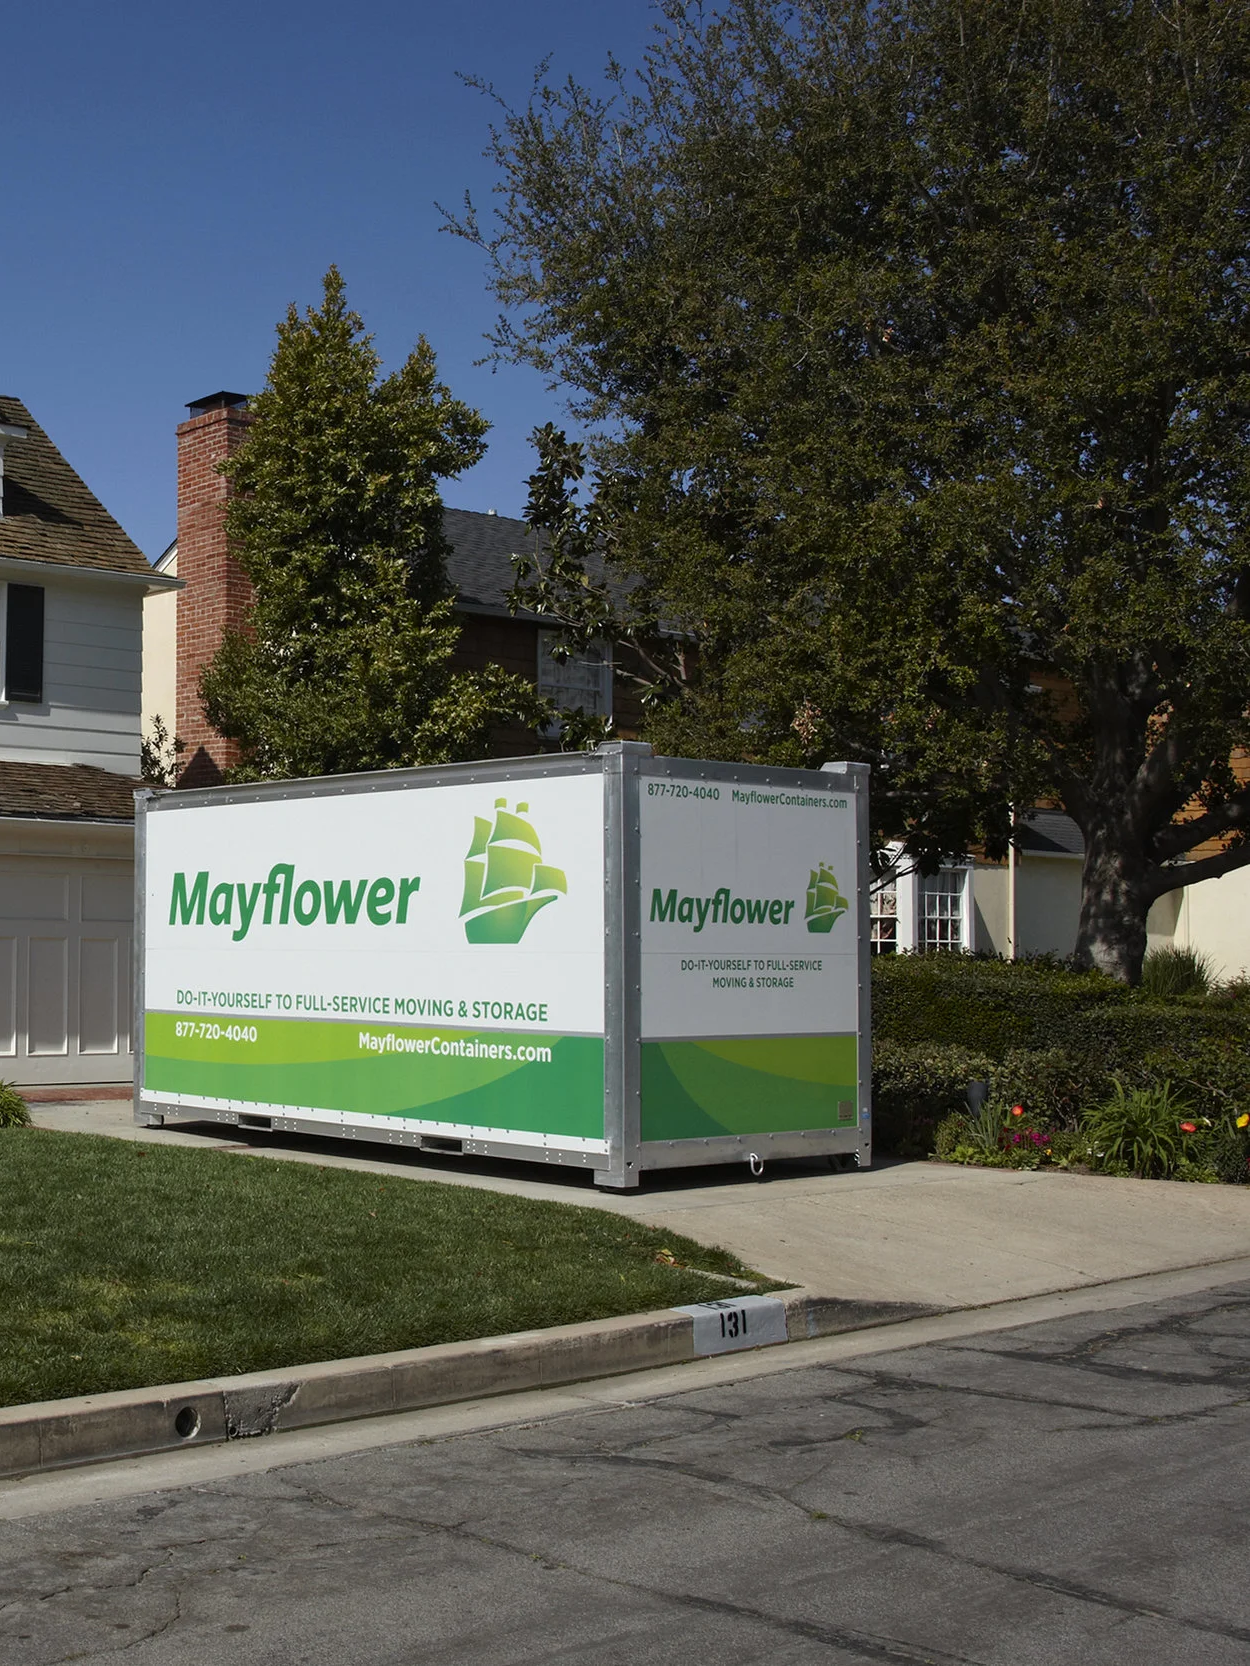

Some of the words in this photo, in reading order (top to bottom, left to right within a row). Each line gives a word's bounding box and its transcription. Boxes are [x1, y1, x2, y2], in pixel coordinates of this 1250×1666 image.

[647, 783, 720, 800] 877-720-4040
[732, 789, 847, 809] MayflowerContainers.com
[168, 863, 421, 942] Mayflower
[649, 888, 795, 933] Mayflower
[681, 959, 751, 971] DO-IT-YOURSELF
[754, 959, 764, 971] TO
[767, 960, 822, 971] FULL-SERVICE
[712, 977, 747, 988] MOVING
[749, 977, 754, 988] &
[756, 977, 794, 988] STORAGE
[176, 989, 272, 1009] DO-IT-YOURSELF
[276, 994, 292, 1010] TO
[295, 994, 390, 1014] FULL-SERVICE
[394, 998, 454, 1018] MOVING
[458, 1000, 468, 1018] &
[472, 1001, 548, 1022] STORAGE
[175, 1021, 258, 1043] 877-720-4040
[358, 1032, 552, 1063] MayflowerContainers.com
[720, 1309, 747, 1338] 131
